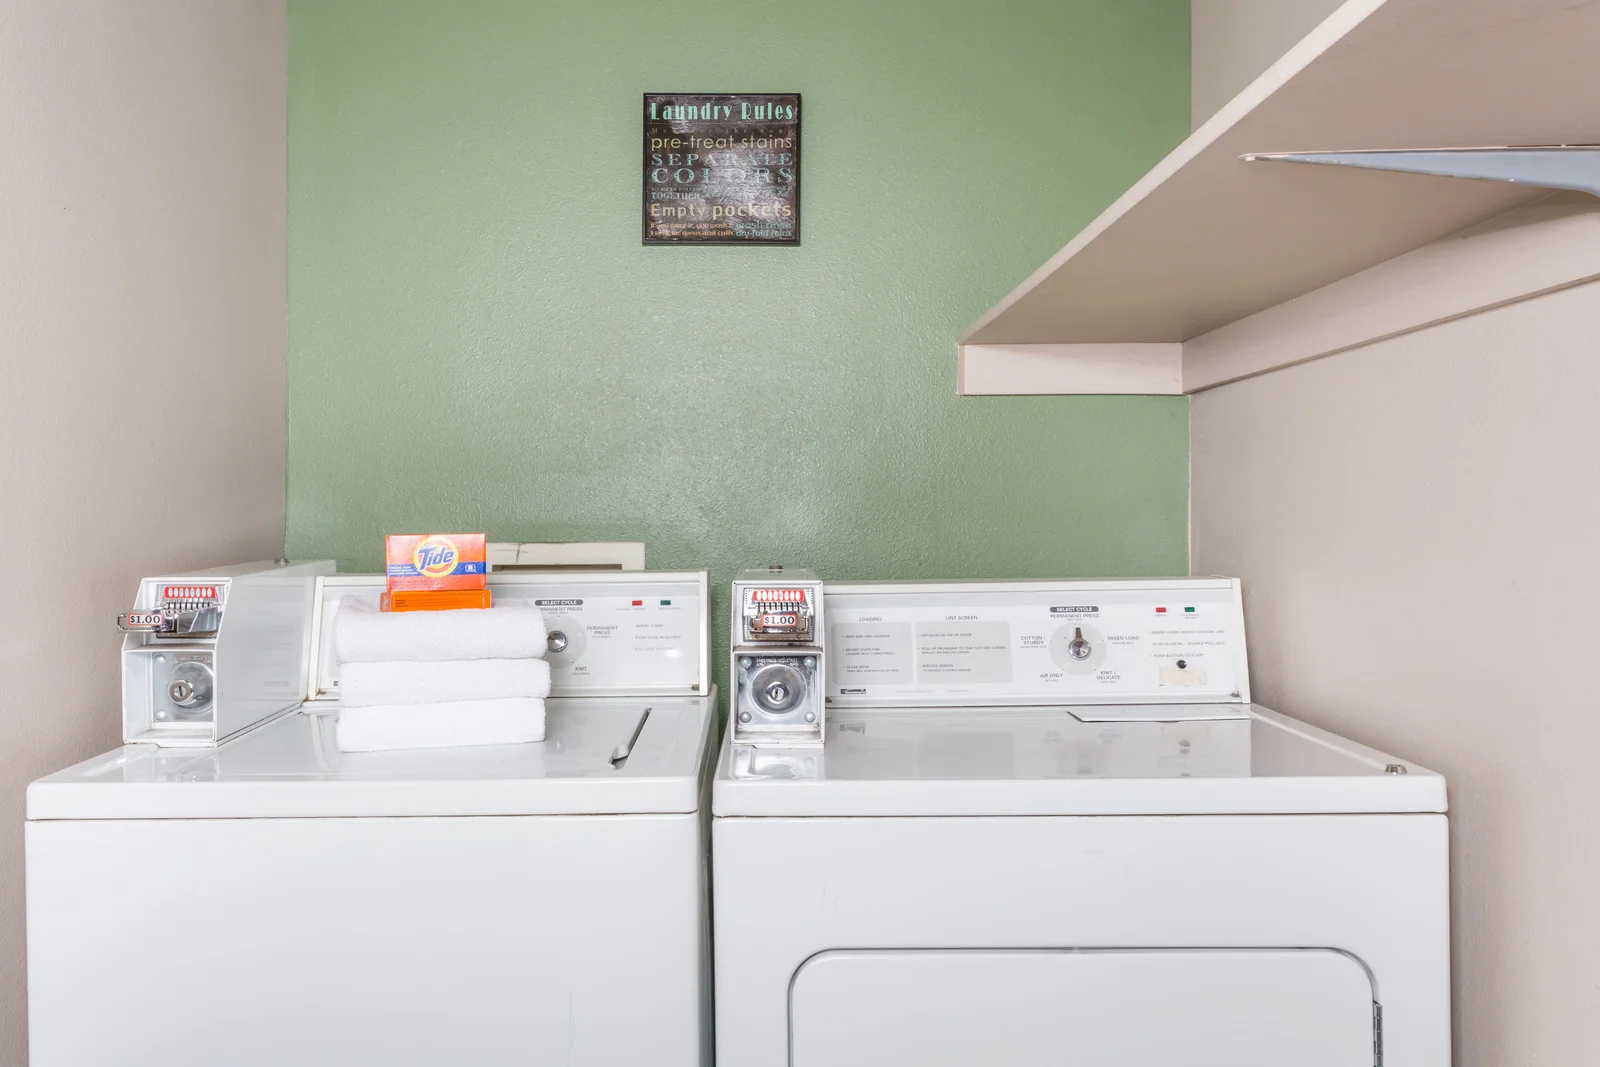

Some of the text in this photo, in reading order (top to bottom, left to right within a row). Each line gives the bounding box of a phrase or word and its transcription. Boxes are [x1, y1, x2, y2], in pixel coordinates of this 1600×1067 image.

[651, 102, 793, 120] Laundry Rules
[651, 134, 792, 152] pre-treat stains
[651, 153, 792, 166] SEPARATE
[651, 167, 793, 184] COLORS
[650, 192, 700, 200] TOGETHER
[650, 202, 792, 220] Empty pockets
[418, 546, 454, 570] Tide
[129, 614, 161, 624] $1.00
[764, 615, 795, 625] $1.00
